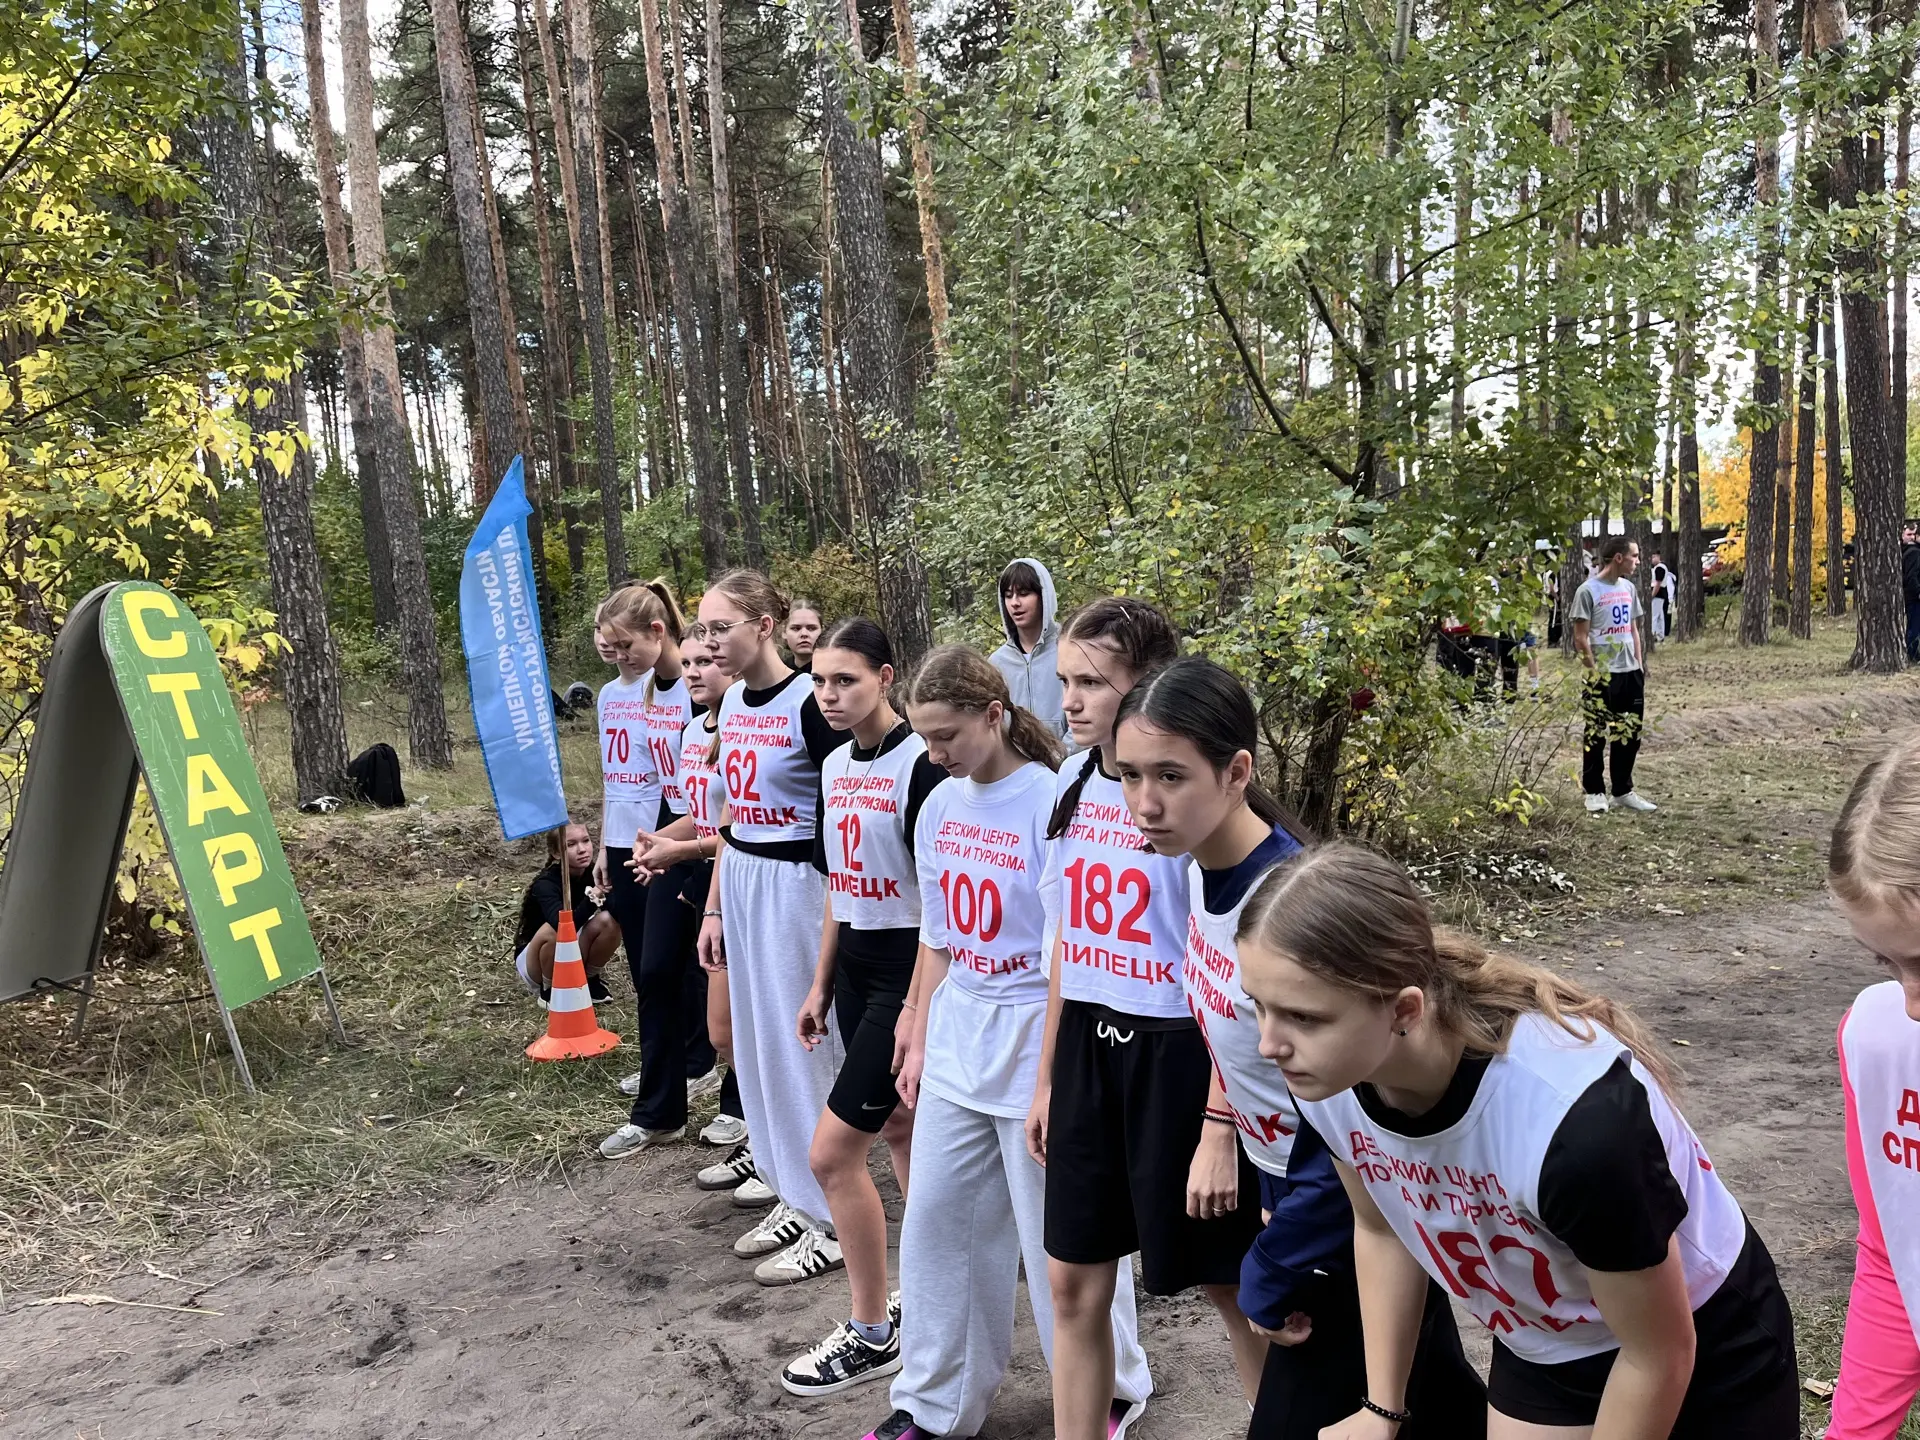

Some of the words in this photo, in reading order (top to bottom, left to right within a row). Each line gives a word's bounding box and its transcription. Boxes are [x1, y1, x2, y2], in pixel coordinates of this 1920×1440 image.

[1612, 604, 1629, 625] 95
[725, 713, 756, 728] ДЕТСКИЙ
[757, 716, 788, 730] ЦЕНТР
[605, 728, 630, 764] 70
[743, 733, 750, 745] И
[750, 733, 792, 748] ТУРИЗМА
[121, 590, 283, 982] СТАРТ
[725, 749, 760, 802] 62
[863, 776, 894, 792] ЦЕНТР
[685, 775, 708, 821] 37
[855, 796, 897, 815] ТУРИЗМА
[1074, 802, 1121, 824] ЕТСКИЙ
[837, 813, 863, 872] 12
[938, 821, 981, 841] ДЕТСКИЙ
[982, 828, 1019, 849] ЦЕНТР
[1098, 829, 1110, 845] И
[1112, 831, 1147, 852] ТУРИ
[963, 845, 972, 860] И
[973, 847, 1026, 873] ТУРИЗМА
[939, 869, 1002, 943] 100
[1064, 857, 1152, 946] 182
[1204, 943, 1235, 983] ЦЕНТР
[1196, 970, 1238, 1022] ТУРИЗМА
[1418, 1192, 1441, 1211] И
